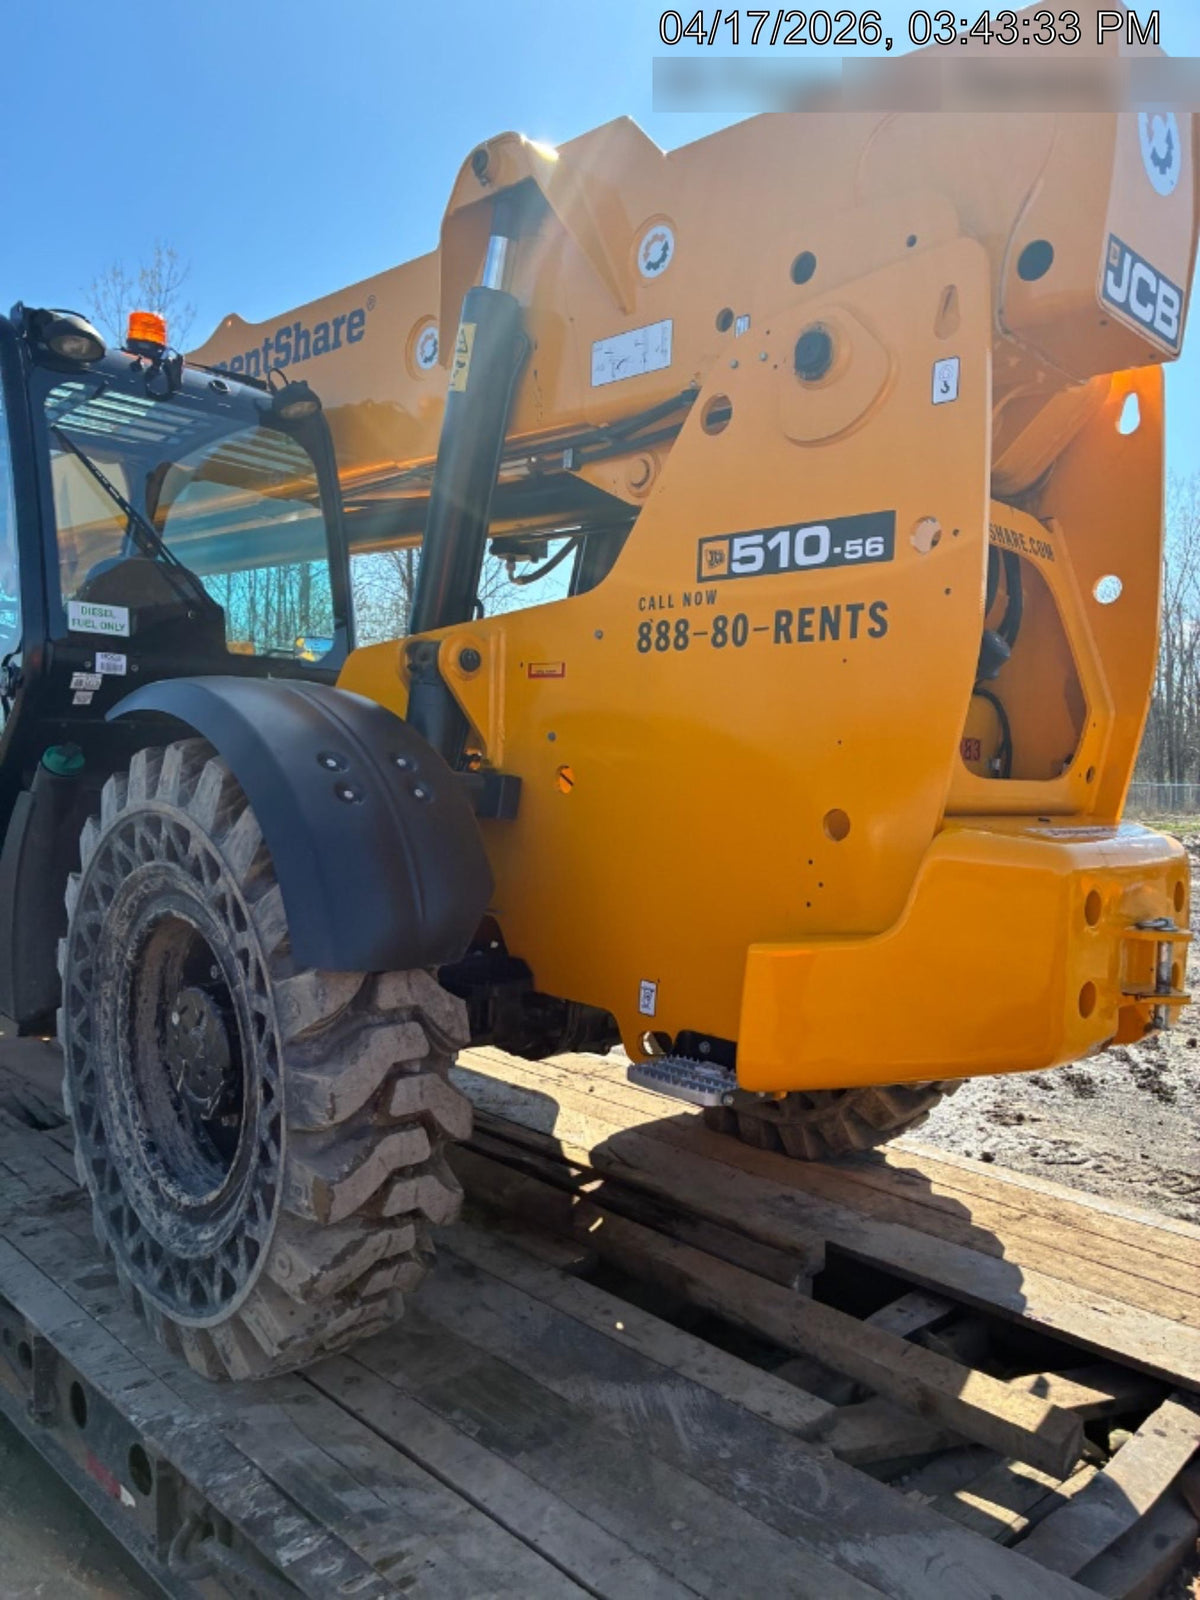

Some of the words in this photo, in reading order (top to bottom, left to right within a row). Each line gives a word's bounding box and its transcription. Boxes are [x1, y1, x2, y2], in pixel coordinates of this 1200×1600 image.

[1106, 252, 1180, 340] JCB
[638, 596, 675, 611] CALL
[682, 589, 718, 607] NOW
[81, 605, 115, 618] DIESEL
[72, 618, 98, 629] FUEL
[101, 622, 126, 632] ONLY
[636, 600, 889, 654] 888-80-RENTS
